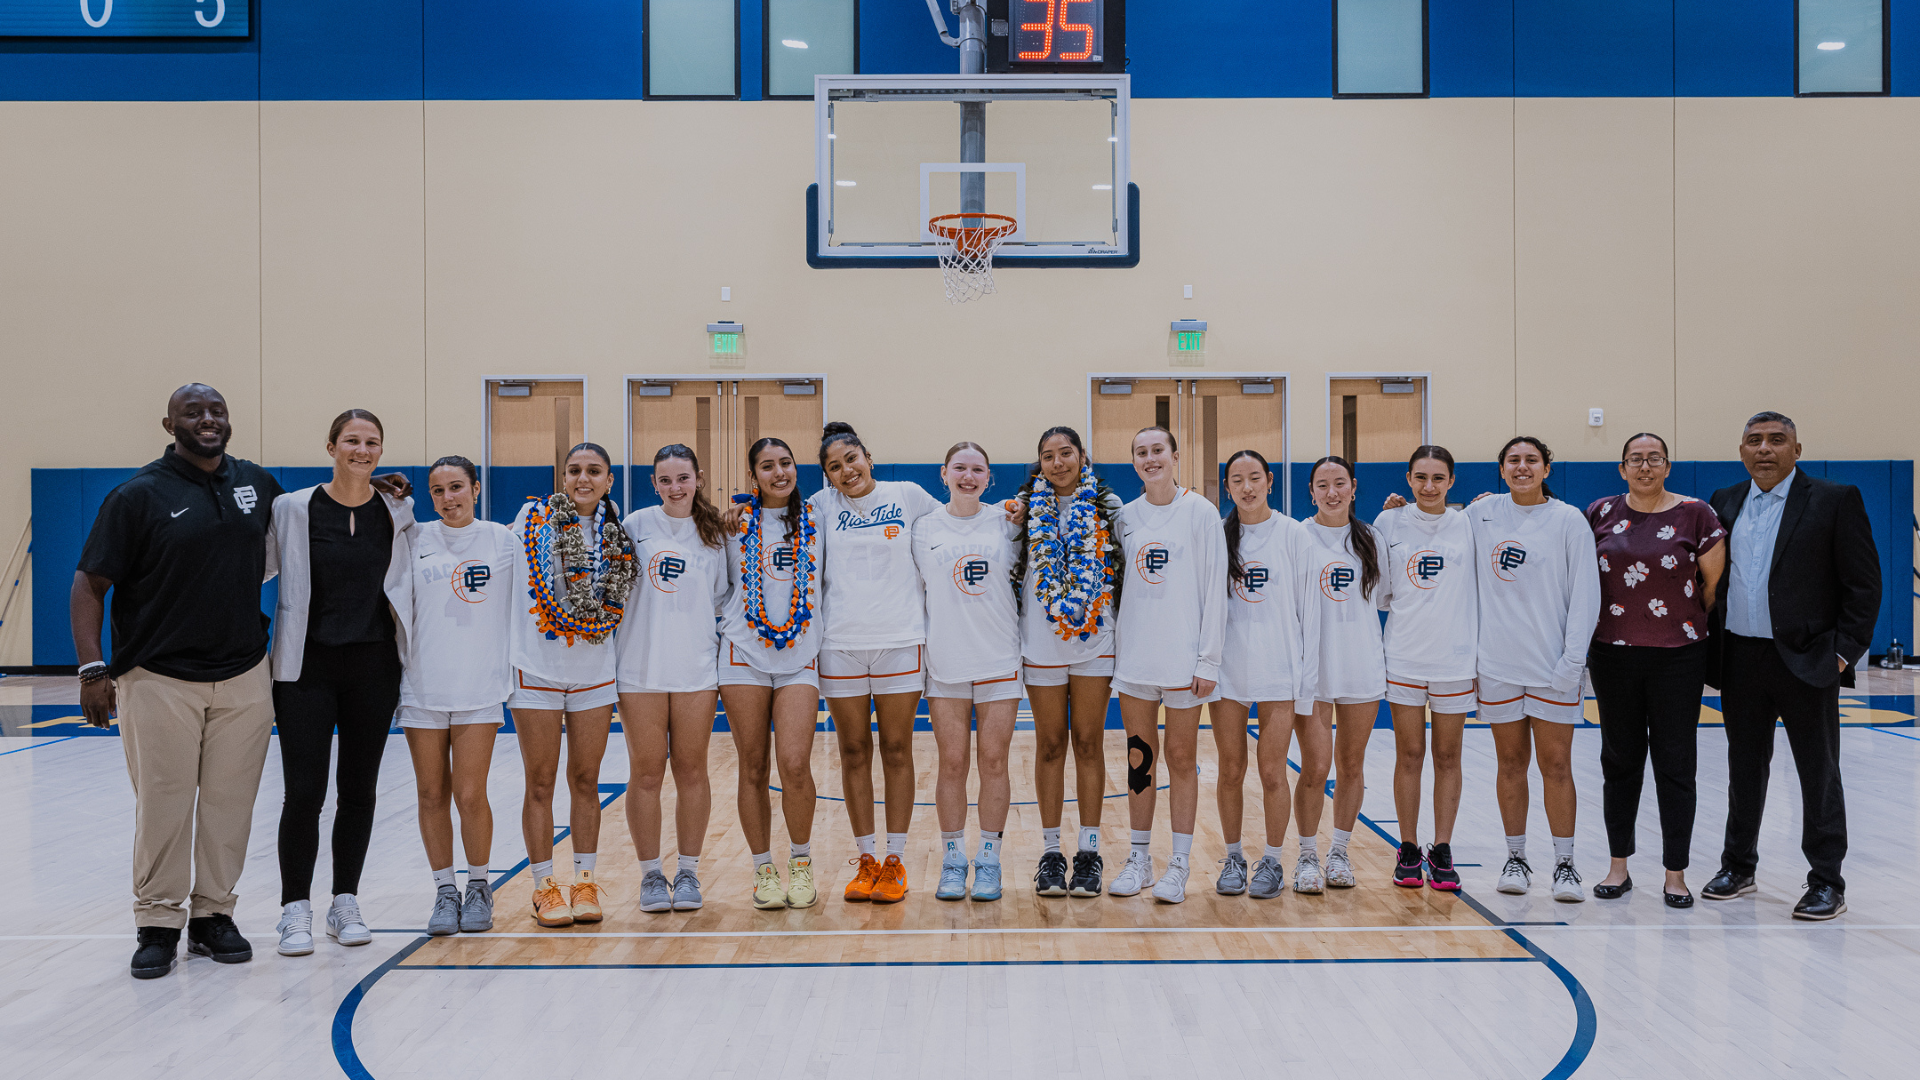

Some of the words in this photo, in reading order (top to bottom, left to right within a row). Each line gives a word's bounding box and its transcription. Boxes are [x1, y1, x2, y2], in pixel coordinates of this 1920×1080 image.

[1018, 0, 1094, 60] 35
[714, 333, 738, 353] EXIT
[1178, 332, 1202, 351] EXIT
[870, 502, 903, 523] Tide
